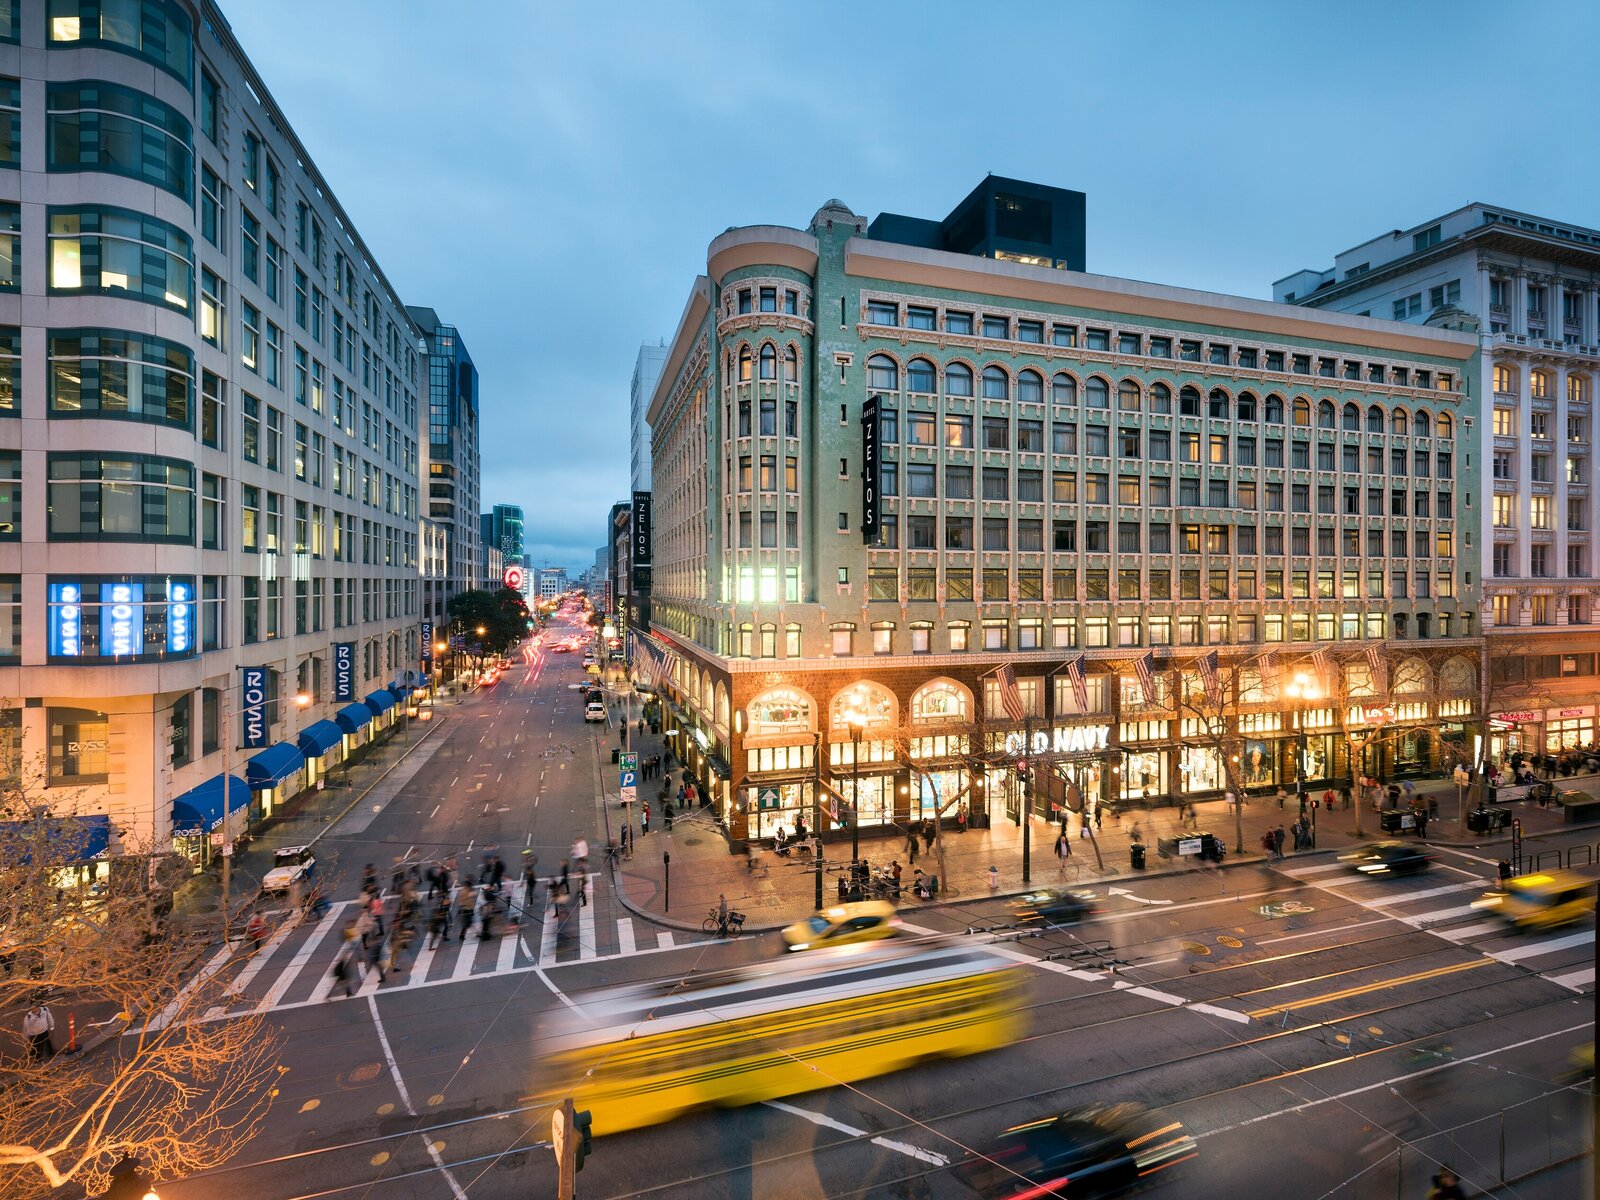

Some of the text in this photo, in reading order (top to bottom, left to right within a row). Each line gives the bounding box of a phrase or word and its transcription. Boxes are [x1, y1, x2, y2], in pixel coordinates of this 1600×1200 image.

[638, 503, 646, 555] ZELOS
[61, 586, 78, 655] ROSS
[111, 586, 132, 655] ROSS
[172, 586, 187, 651] ROSS
[422, 624, 431, 657] ROSS
[338, 646, 350, 696] ROSS
[246, 672, 263, 739] ROSS
[68, 741, 106, 752] ROSS
[1053, 726, 1110, 752] NAVY
[174, 829, 203, 837] ROSS
